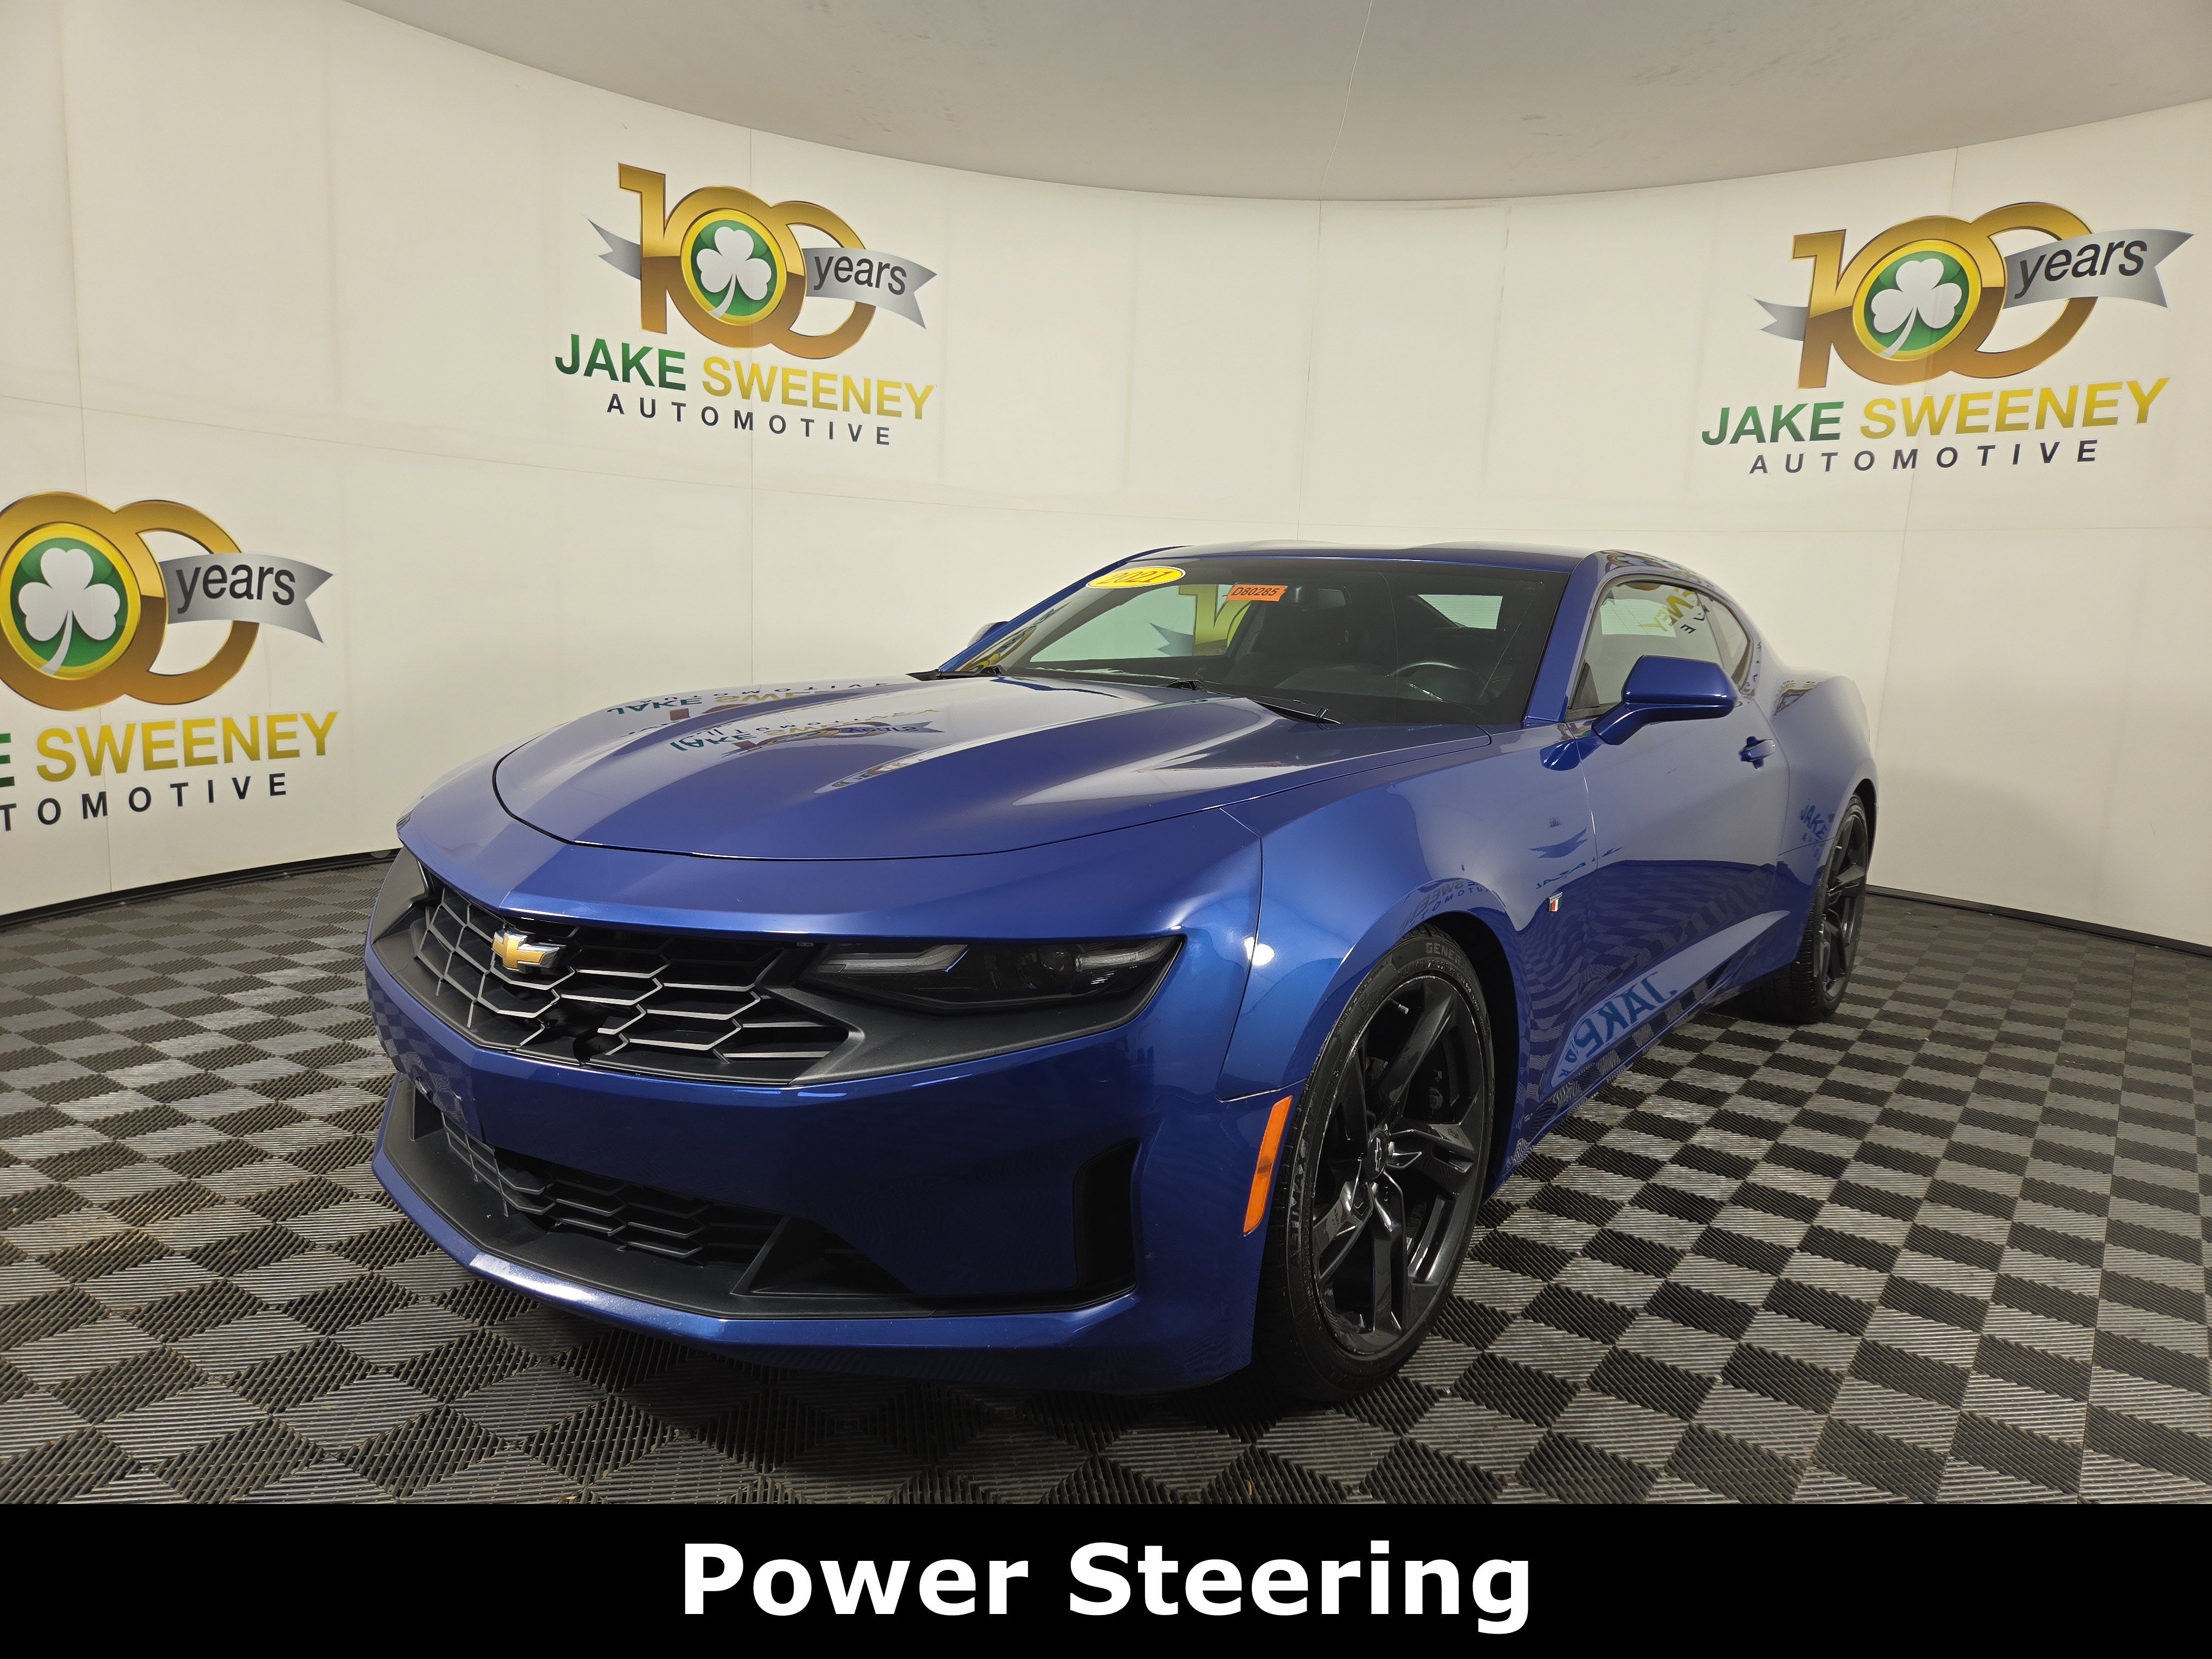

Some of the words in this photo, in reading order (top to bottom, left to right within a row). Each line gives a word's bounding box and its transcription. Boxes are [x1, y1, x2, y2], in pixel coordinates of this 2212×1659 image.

[618, 162, 877, 359] 100
[814, 253, 908, 295] years
[1791, 201, 2097, 389] 100
[2015, 240, 2146, 299] years
[555, 333, 686, 391] JAKE
[702, 356, 935, 420] SWEENEY
[607, 393, 890, 445] AUTOMOTIVE
[1702, 400, 1844, 445] JAKE
[1860, 377, 2171, 439] SWEENEY
[1749, 439, 2098, 474] AUTOMOTIVE
[176, 562, 296, 614] years
[1097, 571, 1175, 585] 2021
[1231, 587, 1281, 596] D80285
[36, 711, 338, 782] SWEENEY
